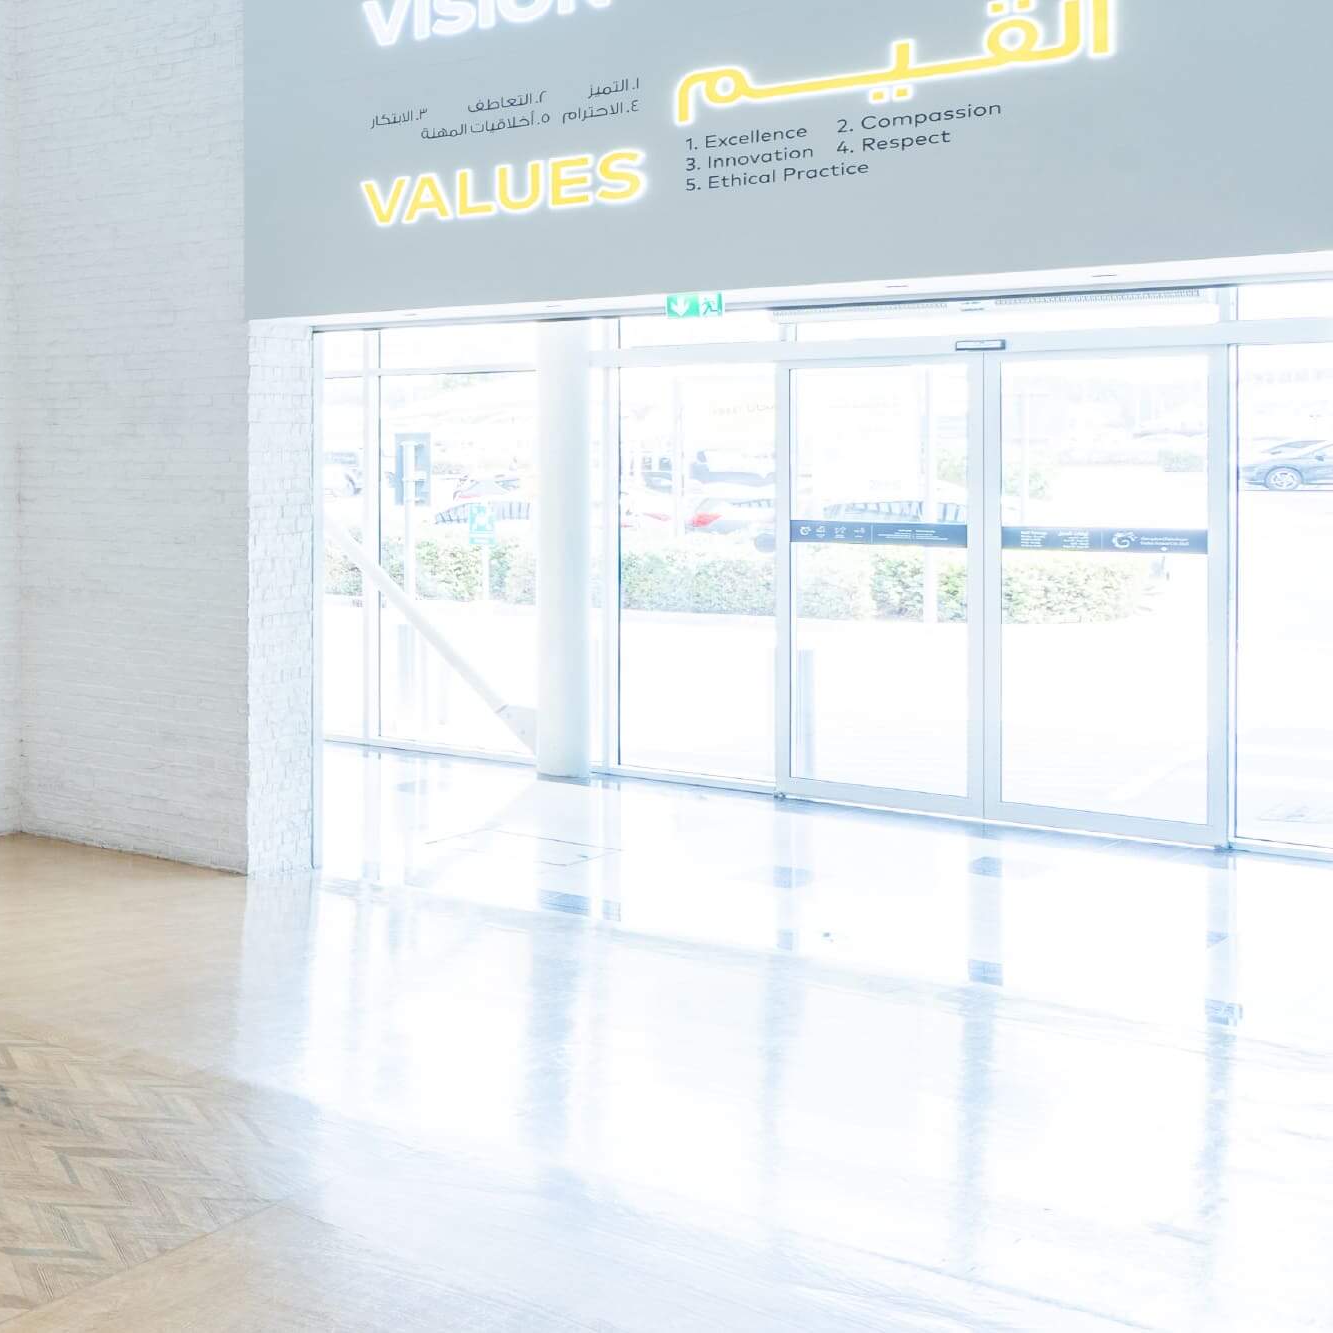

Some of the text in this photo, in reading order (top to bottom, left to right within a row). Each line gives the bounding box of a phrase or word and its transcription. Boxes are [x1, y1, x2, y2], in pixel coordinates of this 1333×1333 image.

[685, 103, 1002, 151] 1. Excellence 2. Compassion
[685, 130, 952, 172] 3. Innovation 4. Respect
[362, 150, 644, 225] VALUES
[685, 162, 870, 192] 5. Ethical Practice
